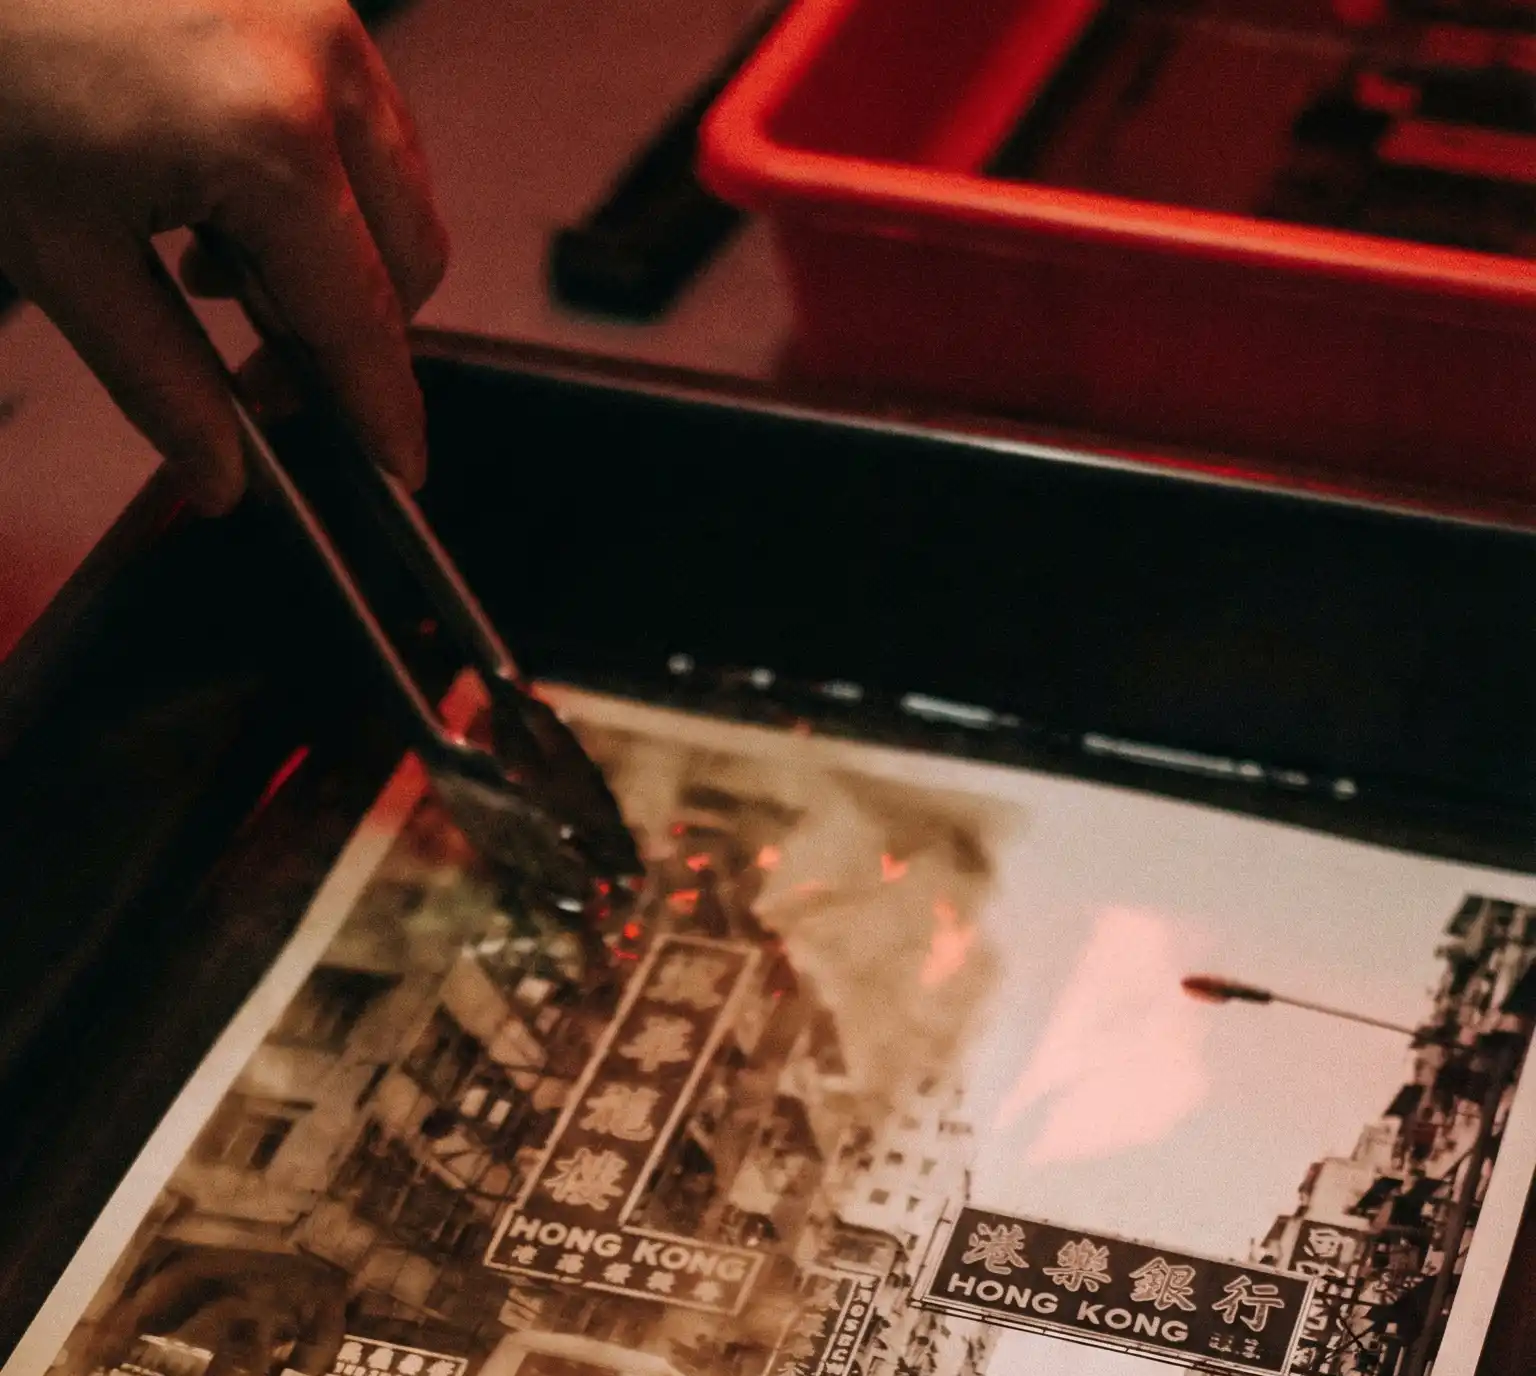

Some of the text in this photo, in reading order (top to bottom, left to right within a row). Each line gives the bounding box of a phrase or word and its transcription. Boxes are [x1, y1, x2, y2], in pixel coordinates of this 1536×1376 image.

[509, 1215, 623, 1257] HONG
[632, 1239, 748, 1281] KONG
[962, 1222, 1285, 1333] 港樂銀行
[947, 1272, 1190, 1343] HONG KONG
